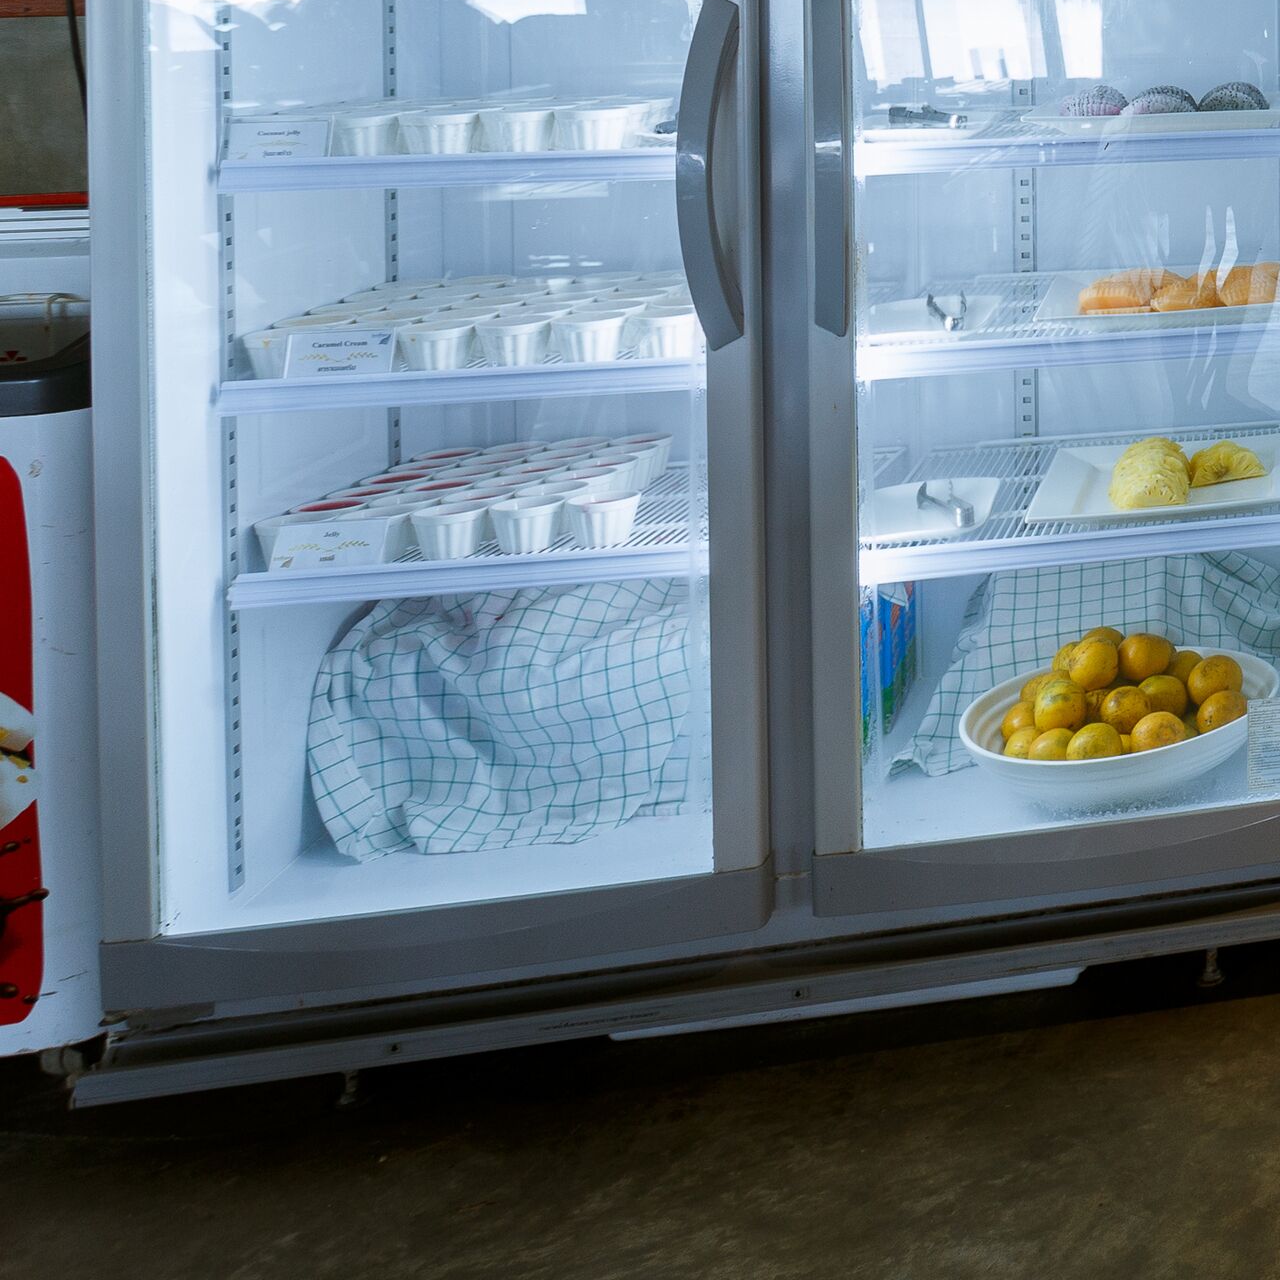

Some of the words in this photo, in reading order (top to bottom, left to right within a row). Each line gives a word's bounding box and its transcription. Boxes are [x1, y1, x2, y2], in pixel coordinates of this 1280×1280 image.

[285, 129, 301, 137] jelly
[312, 341, 343, 349] Caramel
[344, 340, 368, 348] Cream
